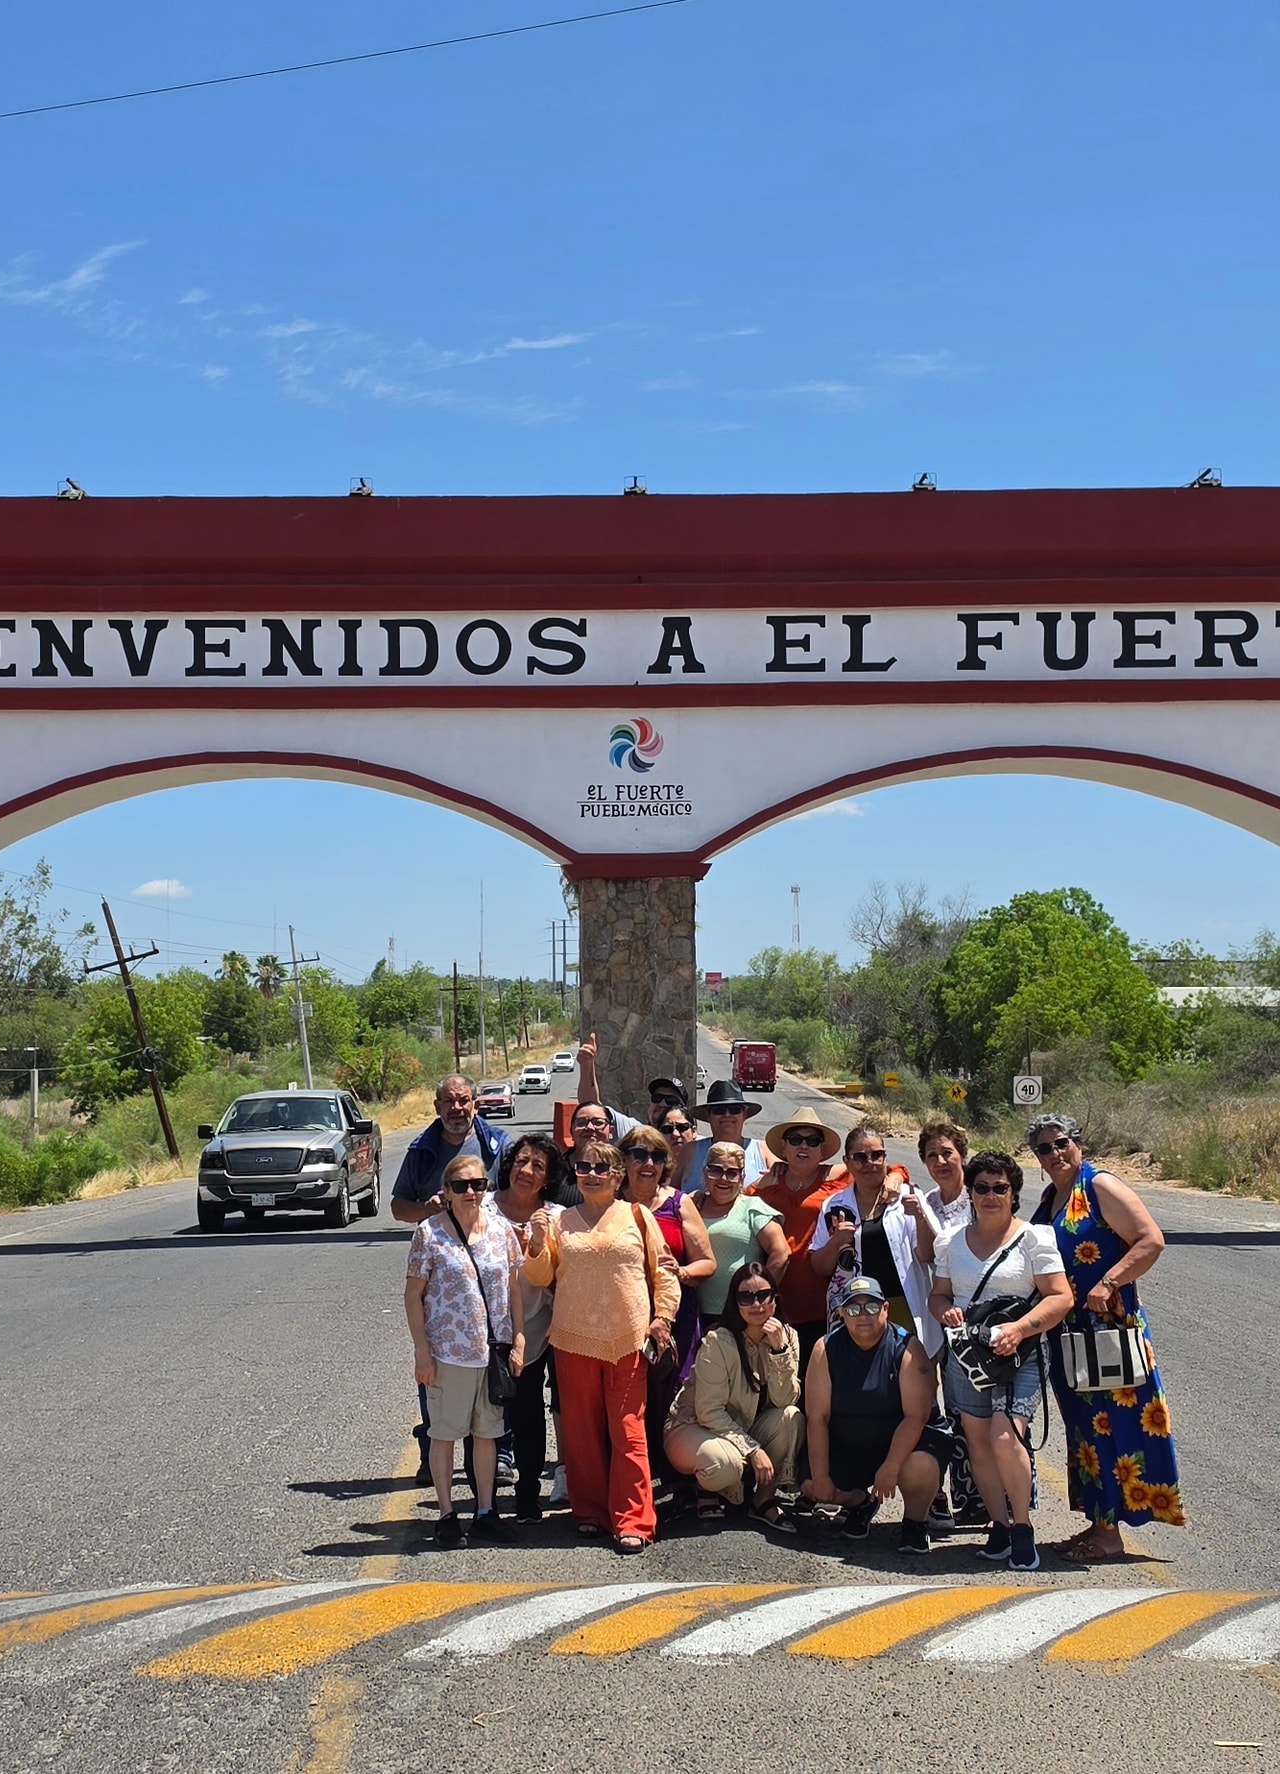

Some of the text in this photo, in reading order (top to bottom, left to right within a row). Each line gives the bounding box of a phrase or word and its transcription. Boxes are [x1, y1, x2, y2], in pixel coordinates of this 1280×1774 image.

[646, 615, 706, 675] A
[765, 614, 898, 674] EL
[1021, 1084, 1035, 1096] 40
